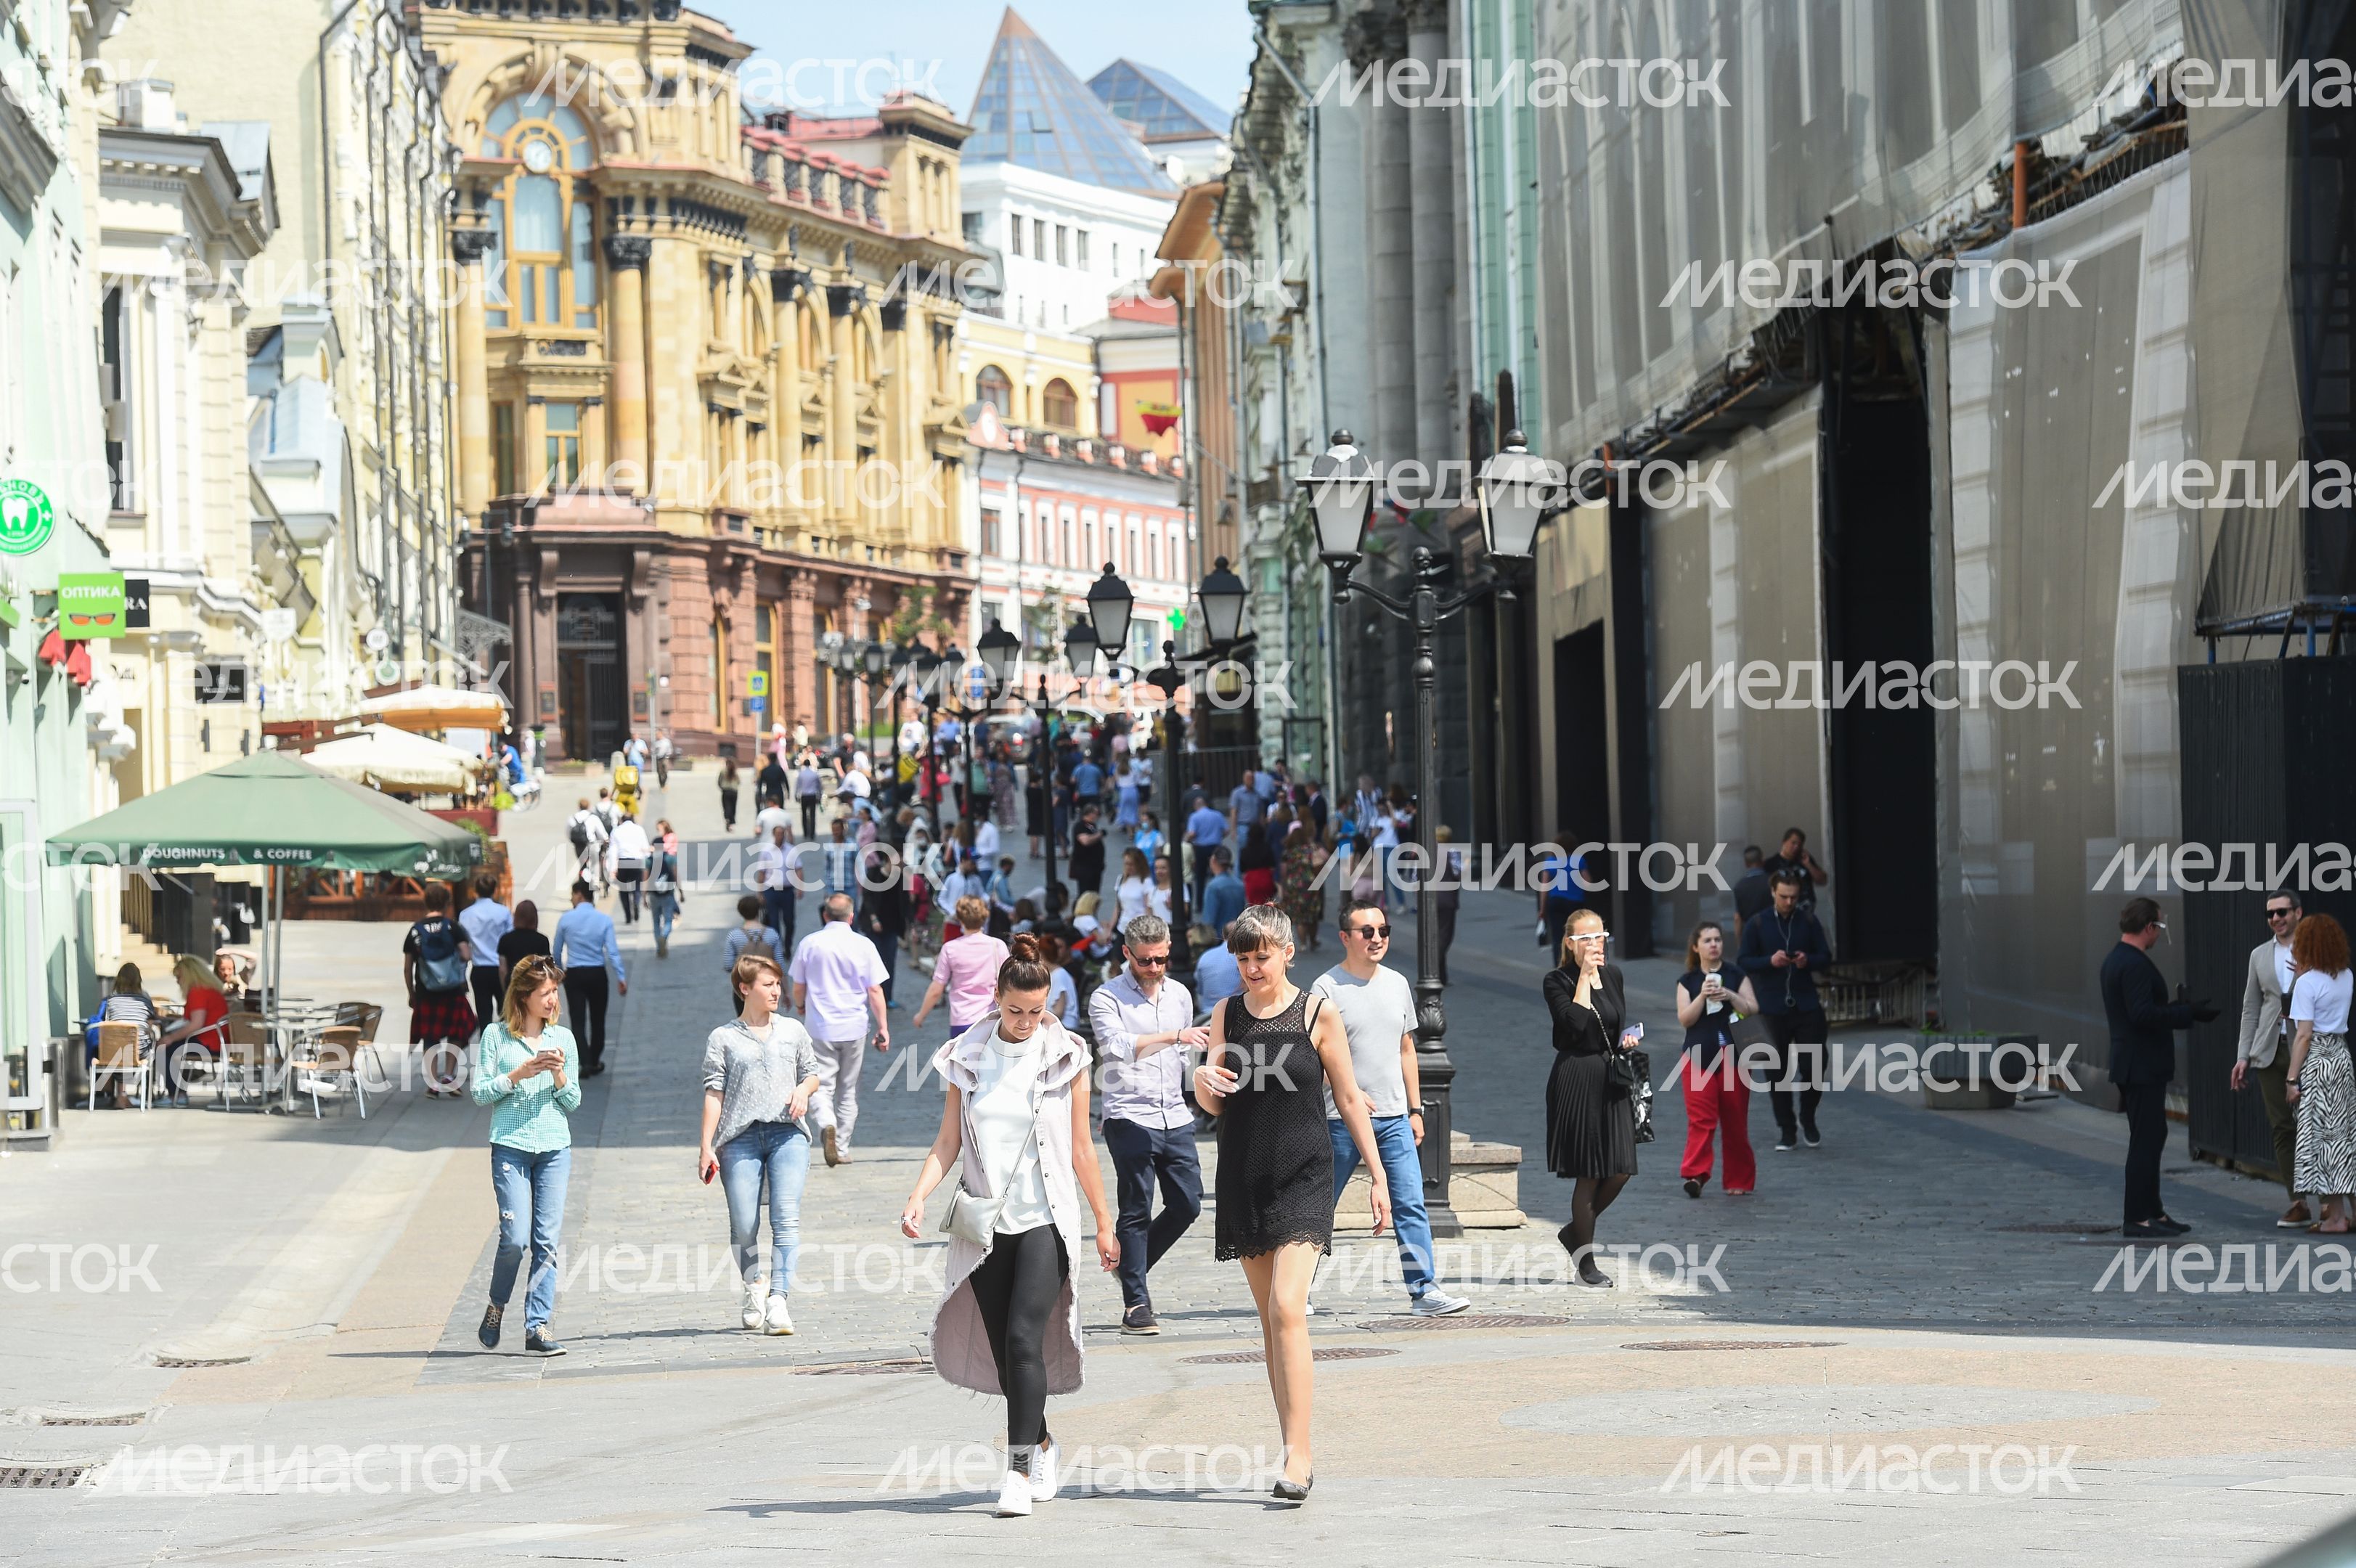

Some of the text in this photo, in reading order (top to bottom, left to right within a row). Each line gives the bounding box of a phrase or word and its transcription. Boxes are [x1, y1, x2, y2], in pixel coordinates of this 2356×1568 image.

[62, 585, 121, 599] ОПТИКА
[142, 847, 226, 859] DOUGHNUTS
[267, 849, 313, 860] COFFEE
